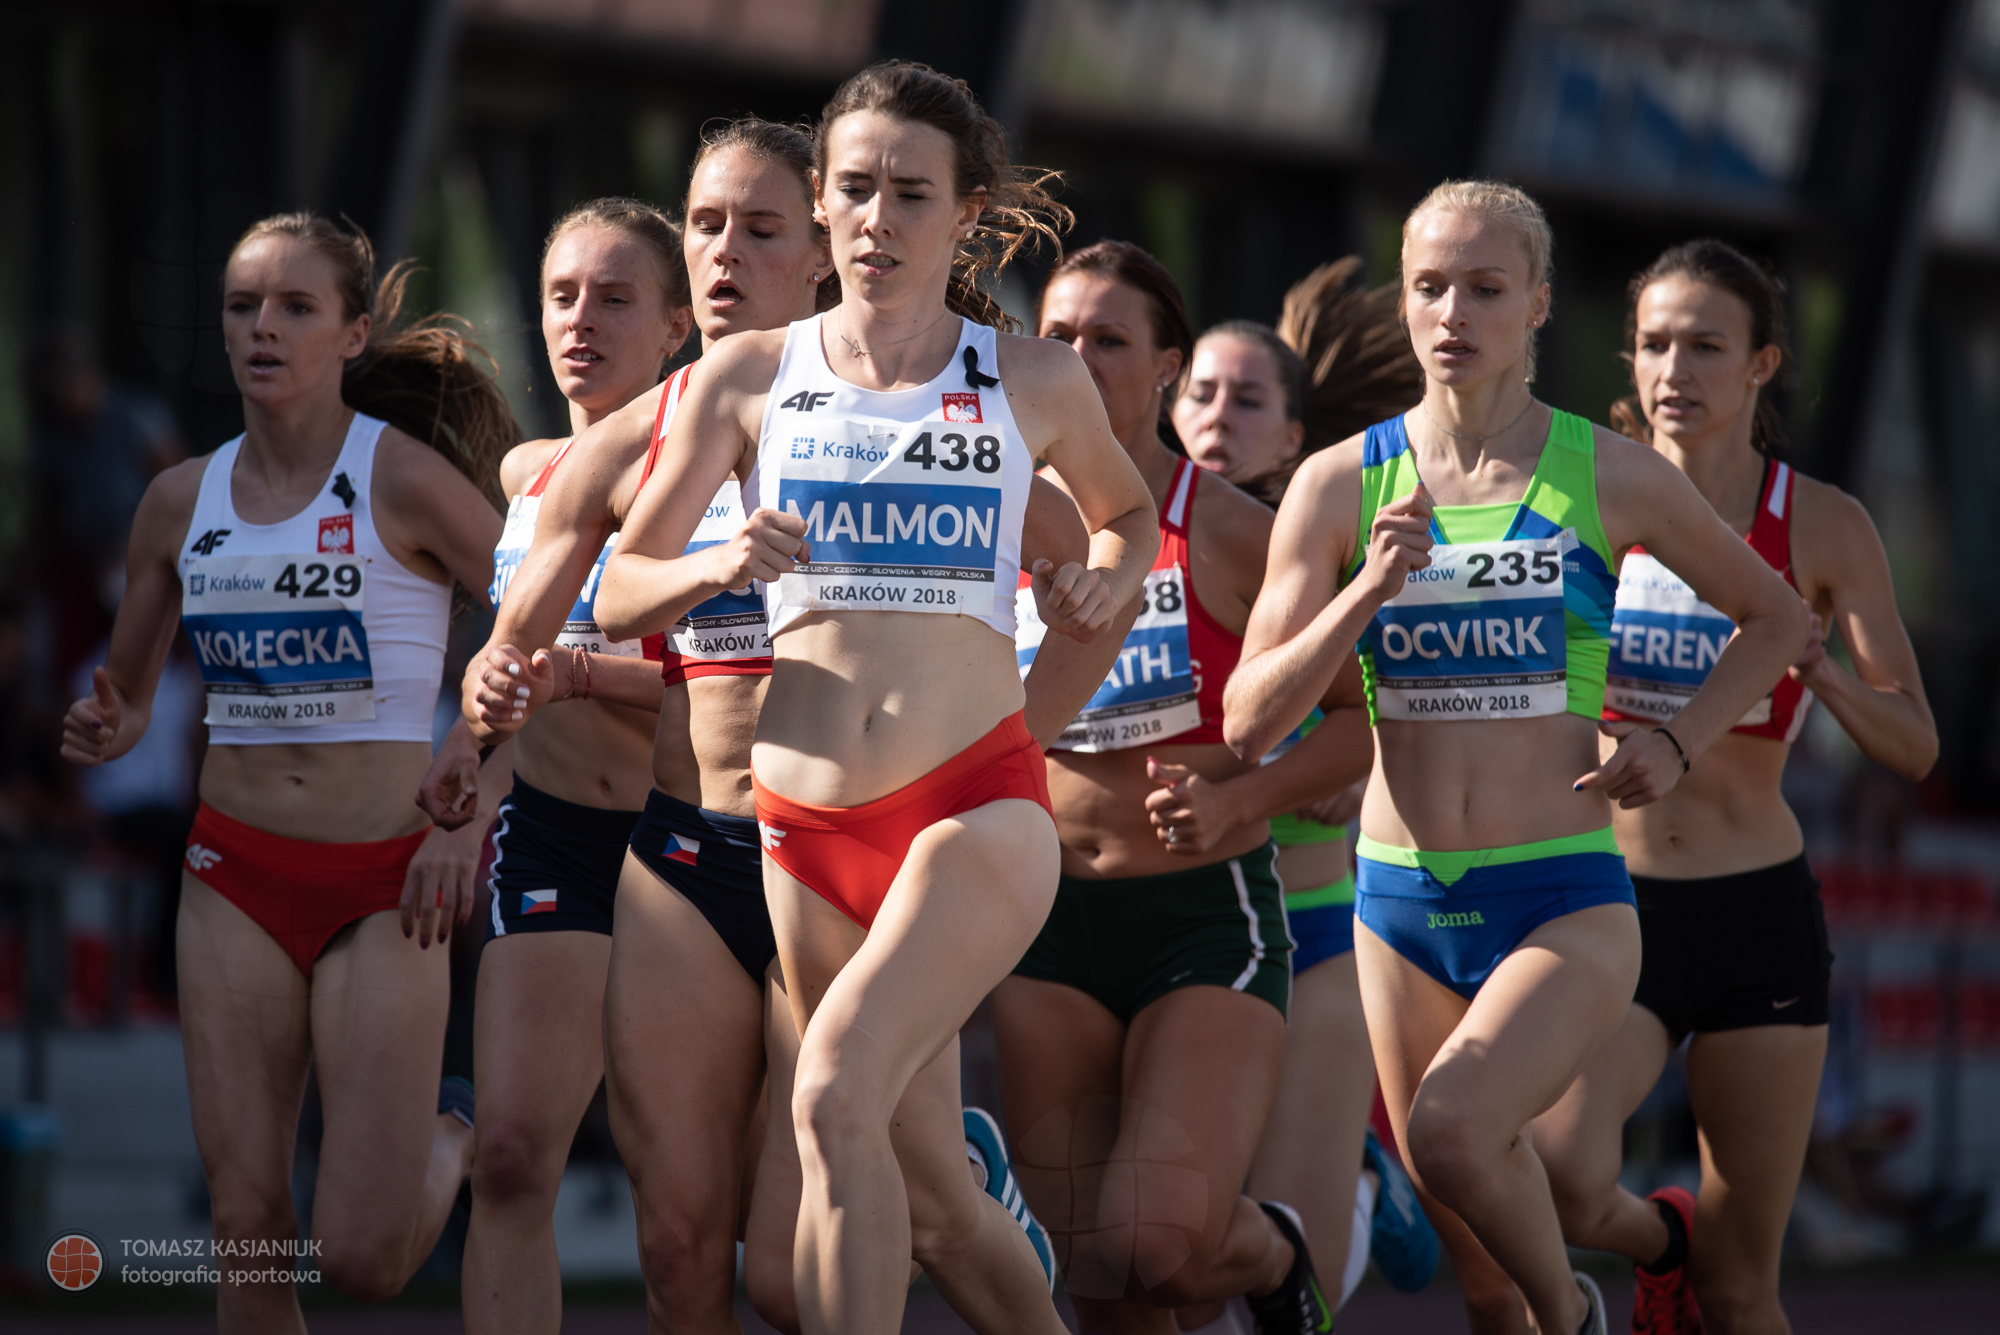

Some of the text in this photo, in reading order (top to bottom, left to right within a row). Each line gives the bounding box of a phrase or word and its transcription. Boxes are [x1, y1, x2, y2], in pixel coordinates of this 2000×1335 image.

[903, 431, 1001, 474] 438
[786, 498, 995, 549] MALMON
[210, 563, 362, 599] Kraków 429
[956, 571, 985, 579] POLSKA
[1407, 564, 1455, 583] aków
[1466, 550, 1560, 589] 235
[819, 582, 956, 605] KRAKÓW 2018
[194, 625, 364, 669] KOŁECKA
[688, 633, 756, 653] KRAKÓW
[1382, 616, 1547, 661] OCVIRK
[1609, 622, 1729, 671] FEREN
[228, 701, 336, 720] KRAKÓW 2018
[1408, 693, 1530, 713] KRAKÓW 2018
[1121, 719, 1162, 740] 2018
